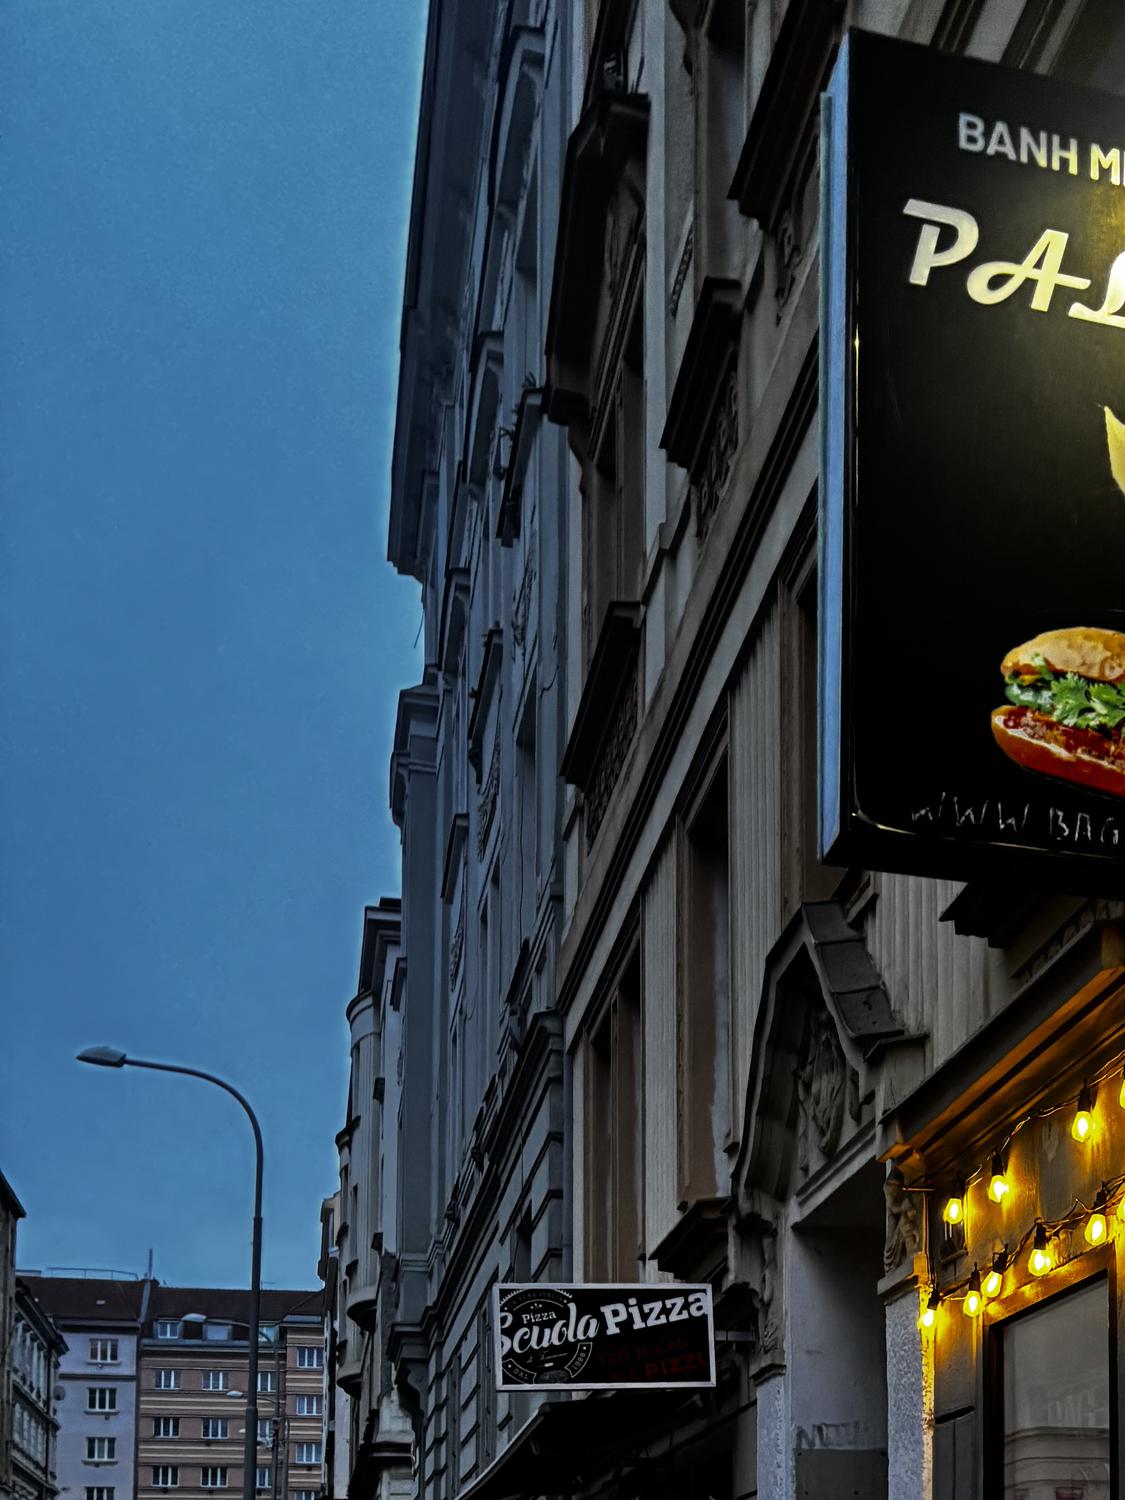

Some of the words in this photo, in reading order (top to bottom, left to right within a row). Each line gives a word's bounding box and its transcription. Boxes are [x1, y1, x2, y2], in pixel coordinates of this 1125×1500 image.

[958, 112, 1079, 176] BANH
[522, 1310, 557, 1325] Pizza
[600, 1291, 709, 1336] Pizza
